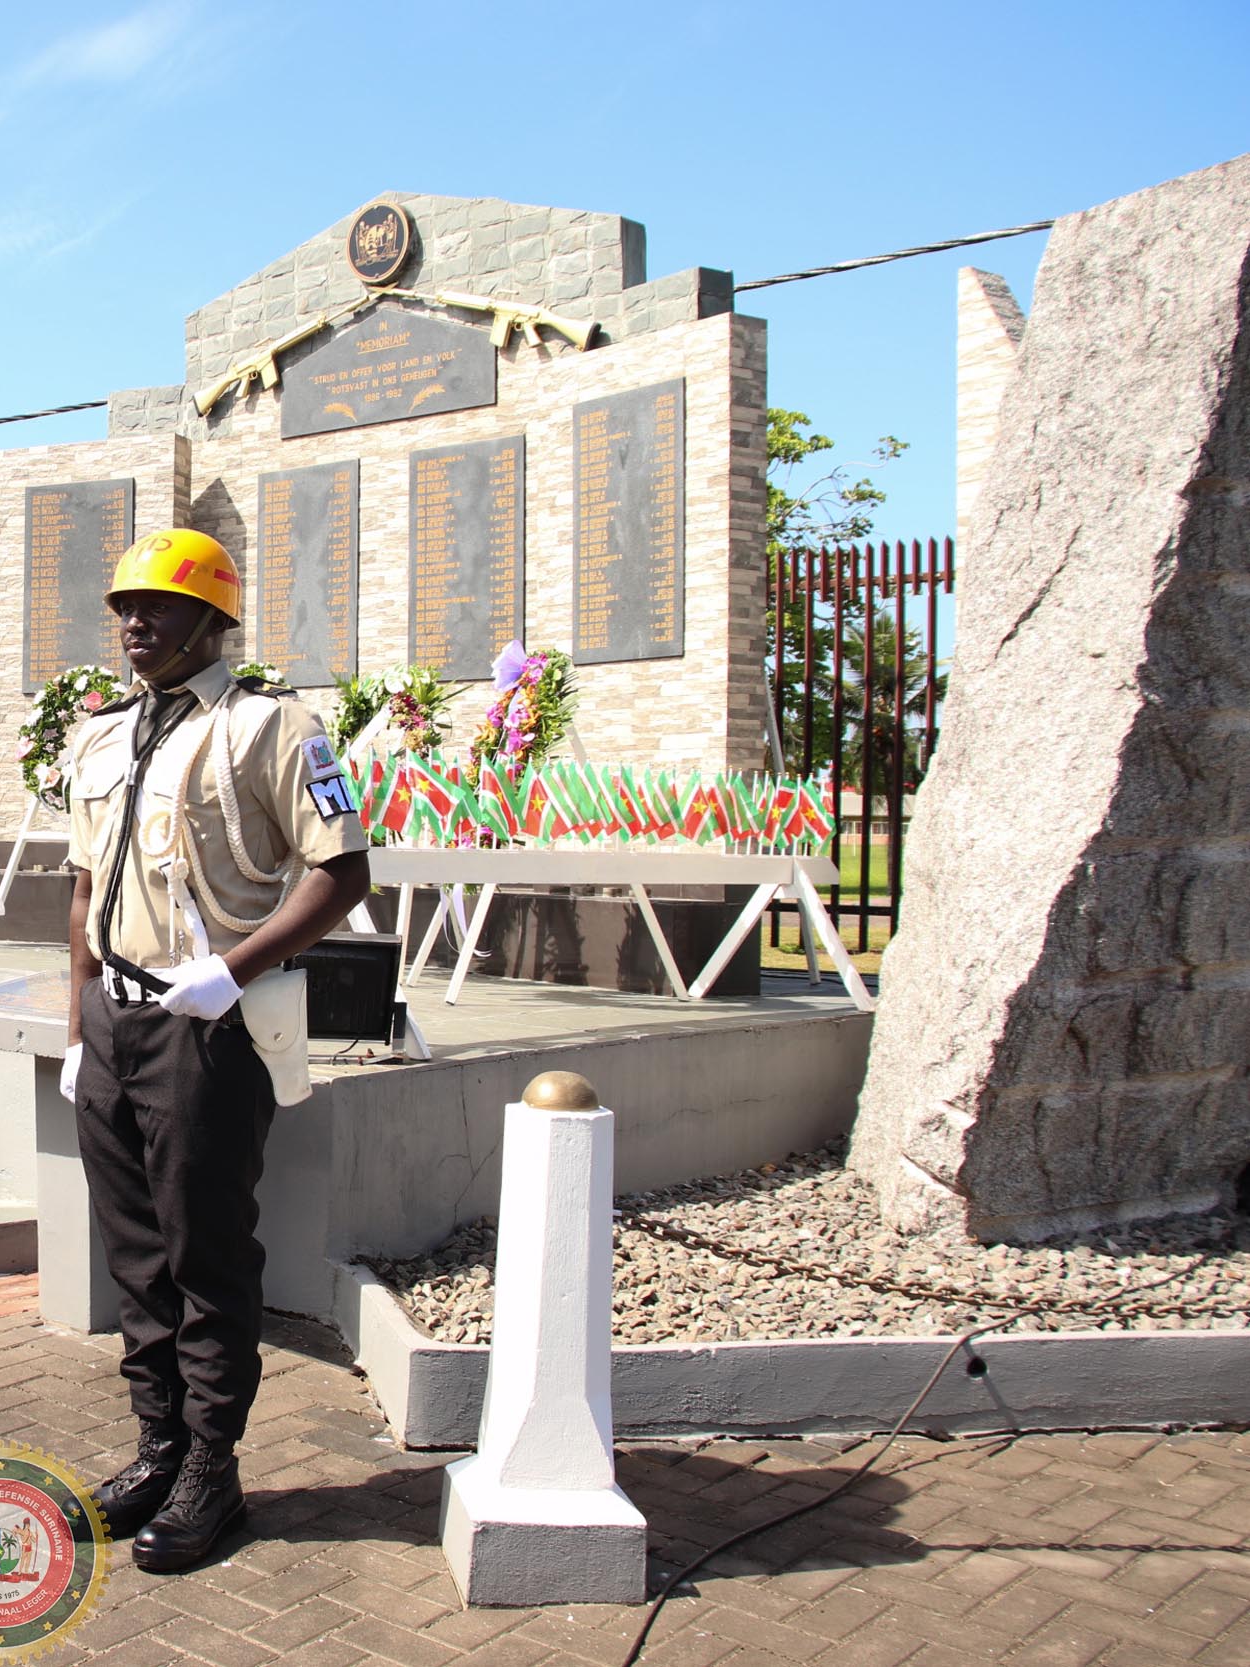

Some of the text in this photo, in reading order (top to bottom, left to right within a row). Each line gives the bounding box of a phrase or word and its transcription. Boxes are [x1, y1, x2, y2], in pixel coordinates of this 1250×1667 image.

[379, 320, 388, 332] IN
[339, 371, 348, 380] EN
[352, 366, 373, 377] OFFER
[377, 361, 397, 373] VOOR
[401, 358, 419, 369] LAND
[422, 356, 432, 365] EN
[372, 378, 379, 387] IN
[383, 375, 397, 385] ONS
[310, 776, 356, 816] M
